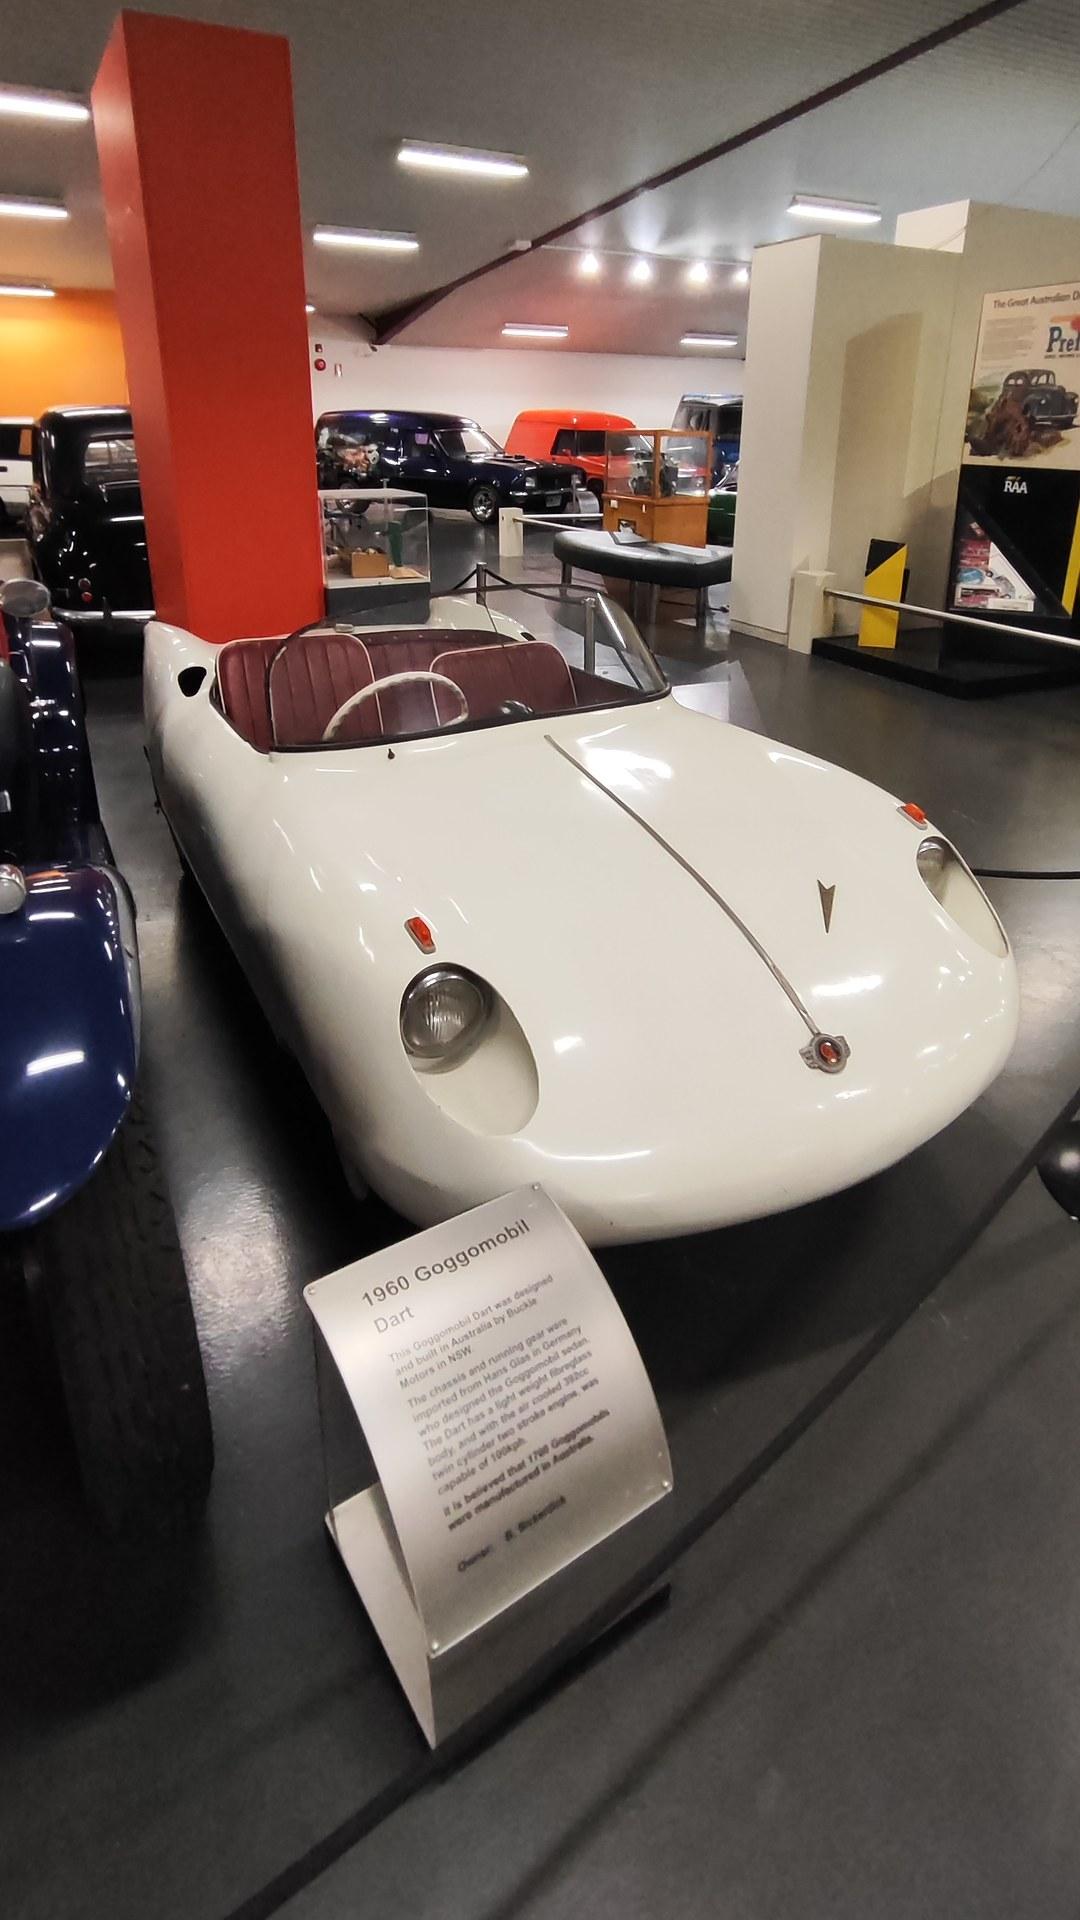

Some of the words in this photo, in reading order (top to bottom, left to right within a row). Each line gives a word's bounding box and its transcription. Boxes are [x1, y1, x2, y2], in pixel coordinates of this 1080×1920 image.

[1003, 480, 1028, 494] RAA
[363, 1275, 411, 1306] 1960
[414, 1218, 529, 1282] Goggomobil
[374, 1305, 414, 1332] Dart
[390, 1348, 411, 1361] This
[413, 1316, 471, 1350] Goggomobil
[472, 1305, 493, 1319] Dart
[495, 1296, 512, 1309] was
[513, 1274, 553, 1299] designed
[395, 1360, 414, 1376] and
[415, 1349, 437, 1365] built
[439, 1344, 450, 1352] in
[450, 1322, 492, 1346] Australia
[493, 1315, 506, 1324] by
[506, 1298, 537, 1317] Buckle
[399, 1367, 435, 1388] Motors
[436, 1360, 447, 1368] in
[408, 1394, 427, 1407] The
[429, 1372, 466, 1396] chassis
[468, 1360, 487, 1375] and
[488, 1342, 525, 1364] running
[525, 1330, 545, 1346] gear
[547, 1318, 568, 1333] were
[413, 1392, 458, 1421] imported
[459, 1380, 482, 1396] from
[483, 1366, 508, 1382] Hans
[509, 1354, 530, 1368] Glas
[531, 1348, 542, 1356] in
[542, 1326, 583, 1350] Germany
[418, 1420, 441, 1436] who
[441, 1393, 487, 1423] designed
[487, 1385, 504, 1397] the
[504, 1351, 560, 1387] Goggomobil
[424, 1436, 443, 1450] The
[444, 1422, 466, 1438] Dart
[467, 1412, 485, 1425] has
[495, 1392, 516, 1408] light
[519, 1374, 548, 1395] weight
[549, 1350, 592, 1376] fibreglass
[432, 1463, 454, 1480] twin
[456, 1439, 496, 1466] cylinder
[497, 1427, 516, 1441] two
[517, 1408, 546, 1430] stroke
[582, 1378, 599, 1391] was
[458, 1432, 477, 1447] and
[479, 1419, 499, 1434] with
[500, 1411, 516, 1423] the
[532, 1382, 563, 1404] cooled
[437, 1467, 476, 1494] capable
[479, 1457, 490, 1469] of
[464, 1472, 506, 1502] believed
[507, 1459, 526, 1475] that
